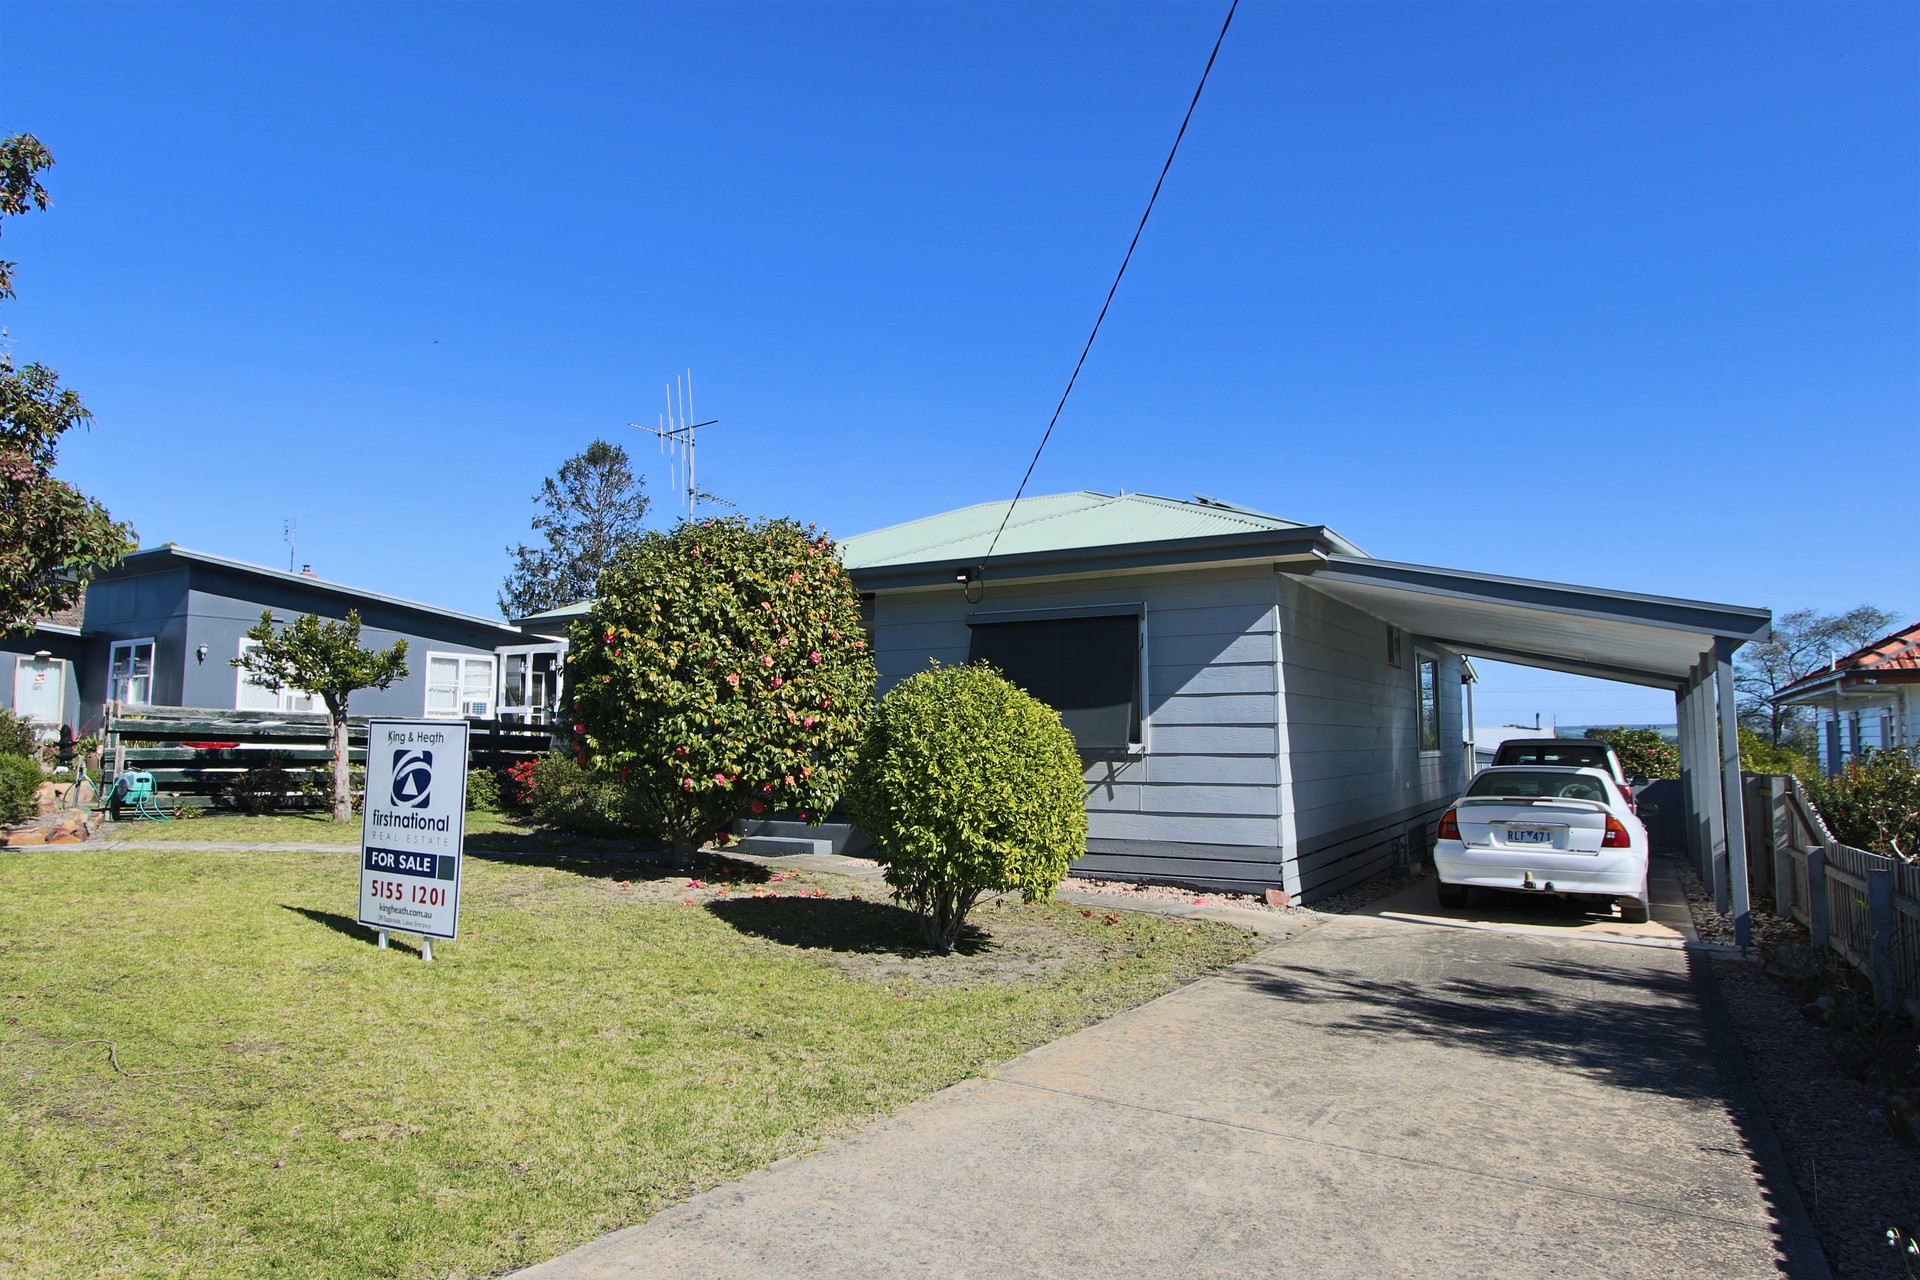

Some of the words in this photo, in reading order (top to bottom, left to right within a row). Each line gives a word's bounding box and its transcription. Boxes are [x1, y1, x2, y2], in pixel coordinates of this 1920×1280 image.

[388, 730, 406, 745] King
[408, 731, 414, 742] &
[417, 731, 444, 745] Heath
[372, 808, 450, 832] firstnational
[372, 830, 397, 842] REAL
[406, 834, 449, 847] ESTATE
[371, 851, 395, 868] FOR
[398, 854, 431, 872] SALE
[371, 879, 403, 901] 5155
[412, 885, 446, 907] 1201
[379, 902, 433, 919] kingheath.com.au
